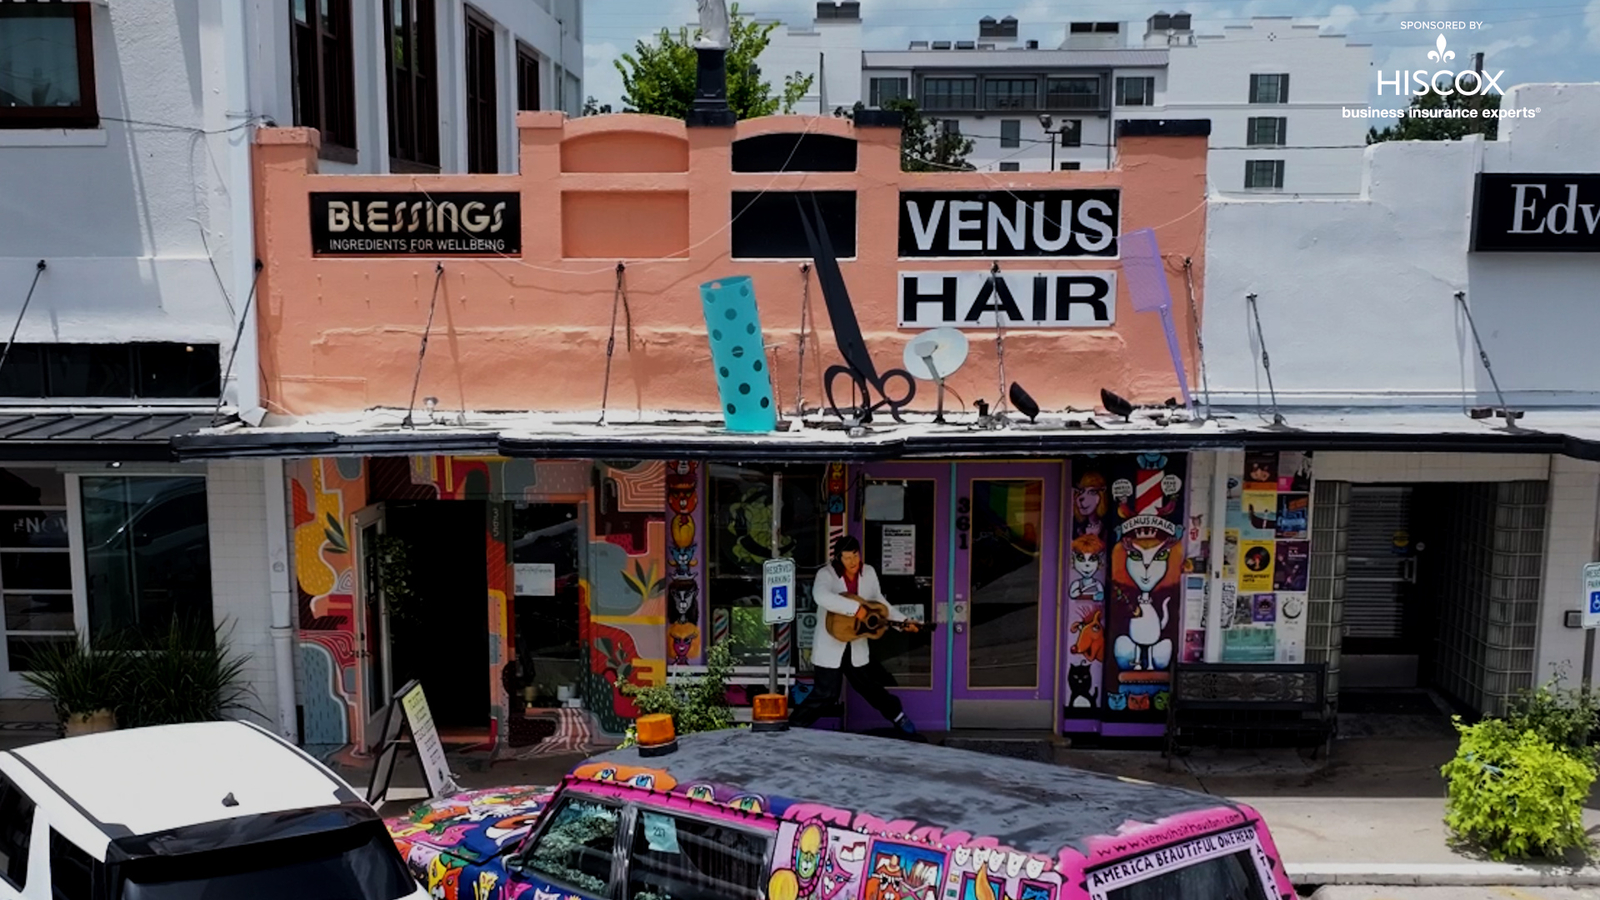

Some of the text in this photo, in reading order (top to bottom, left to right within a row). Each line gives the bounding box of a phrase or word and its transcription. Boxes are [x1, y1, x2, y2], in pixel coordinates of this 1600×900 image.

[906, 199, 1113, 252] VENUS
[329, 239, 505, 251] INGREDIENTS FOR WELLBEING
[903, 275, 1109, 322] HAIR
[956, 497, 970, 549] 361
[1123, 516, 1151, 530] VENUS
[766, 563, 792, 574] RESERVED
[767, 574, 791, 586] PARKING
